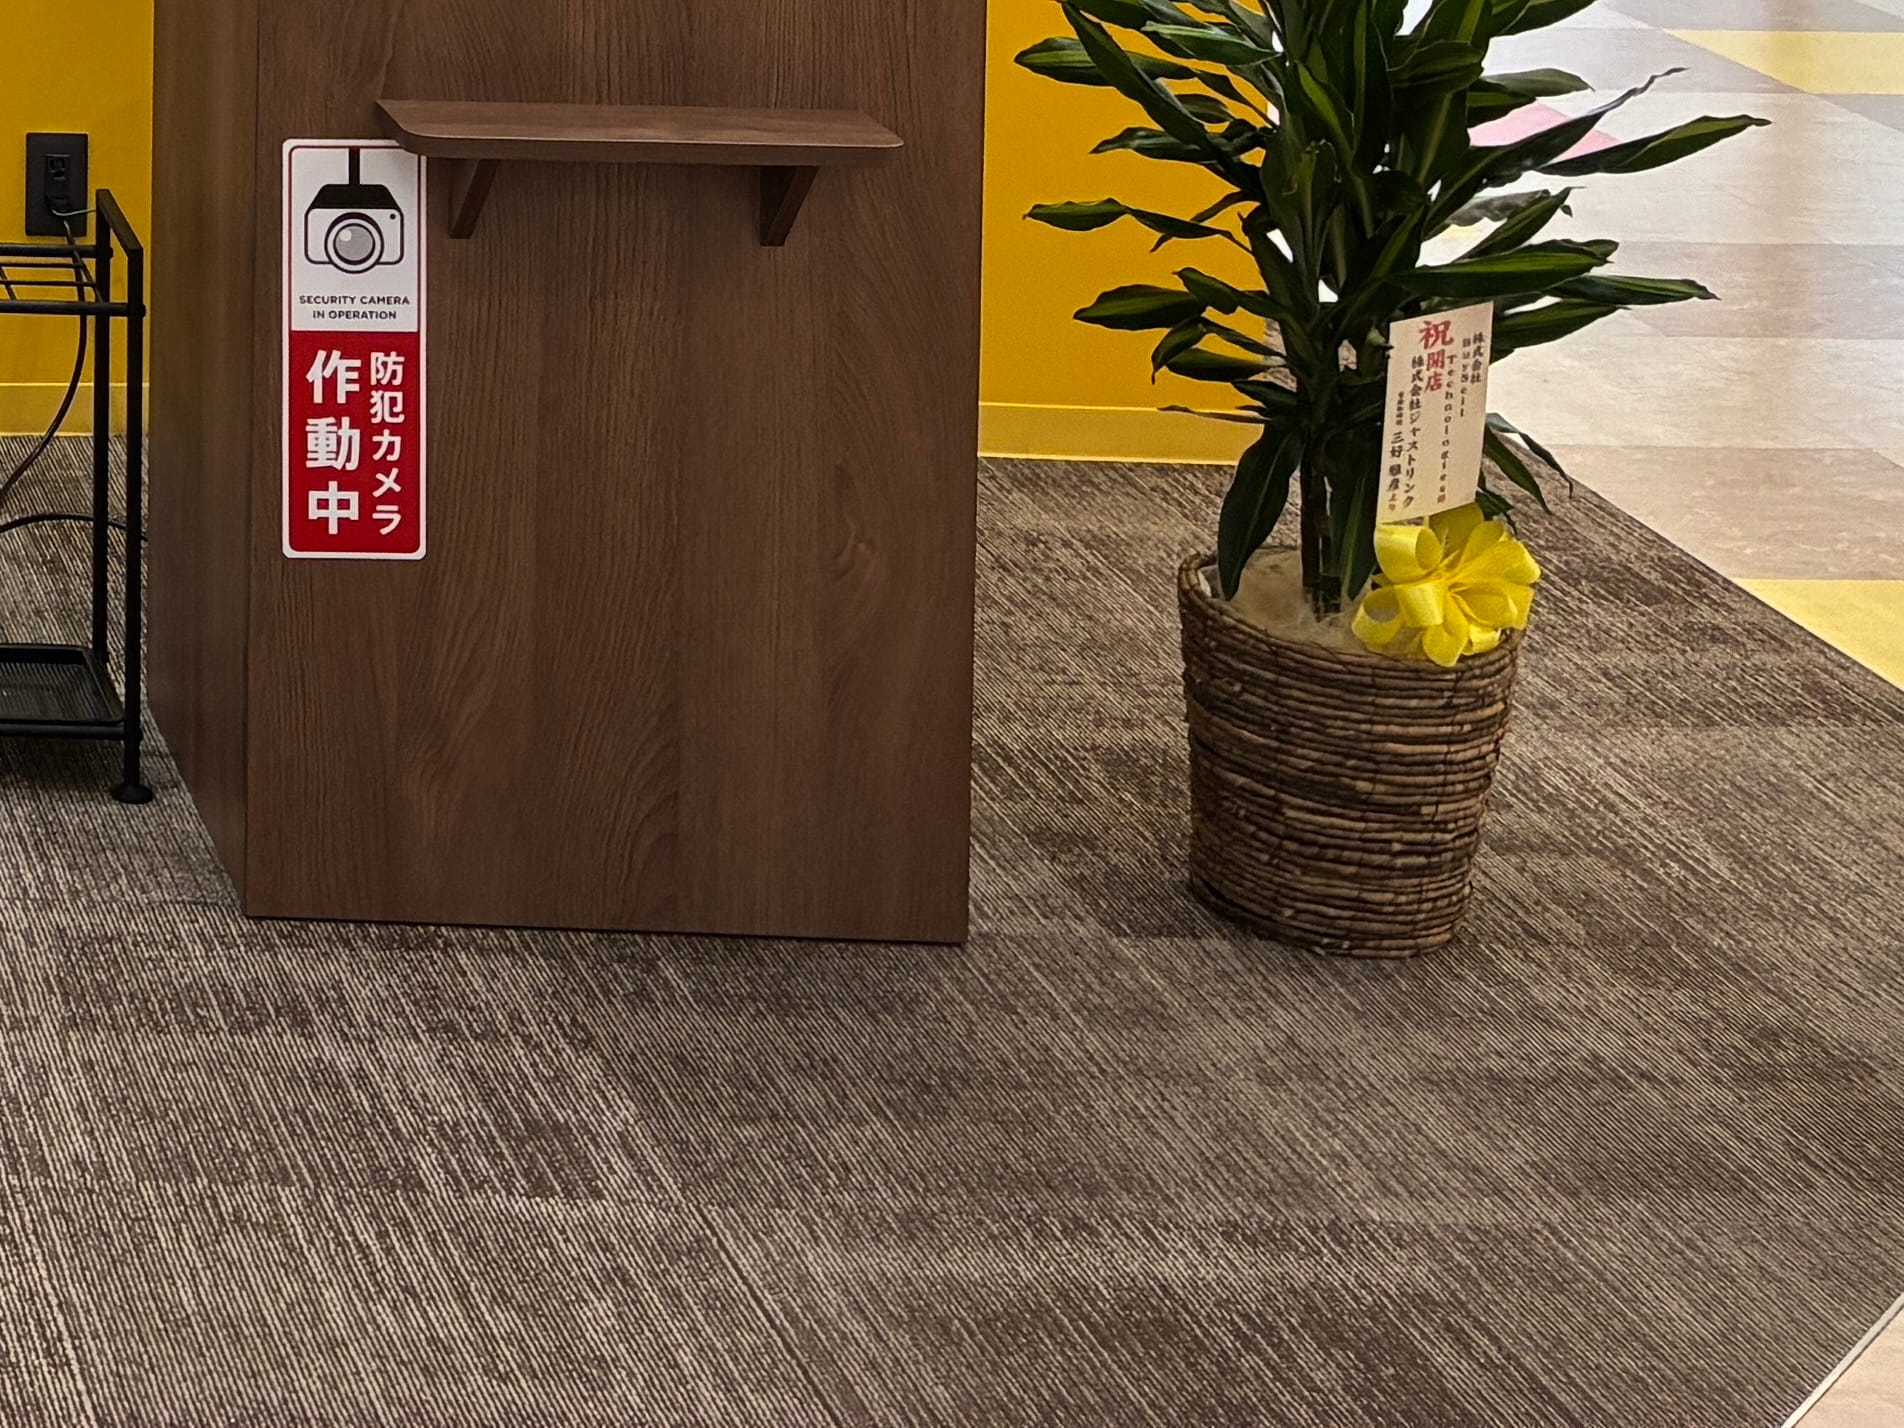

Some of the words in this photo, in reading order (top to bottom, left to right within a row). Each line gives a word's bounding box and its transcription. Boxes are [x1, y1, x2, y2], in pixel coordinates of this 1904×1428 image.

[299, 295, 356, 306] SECURITY
[360, 295, 410, 306] CAMERA
[312, 310, 325, 321] IN
[328, 310, 397, 321] OPERATION
[1470, 331, 1486, 385] 株式会社
[305, 349, 361, 535] 作動中
[369, 351, 405, 535] 防犯カメラ
